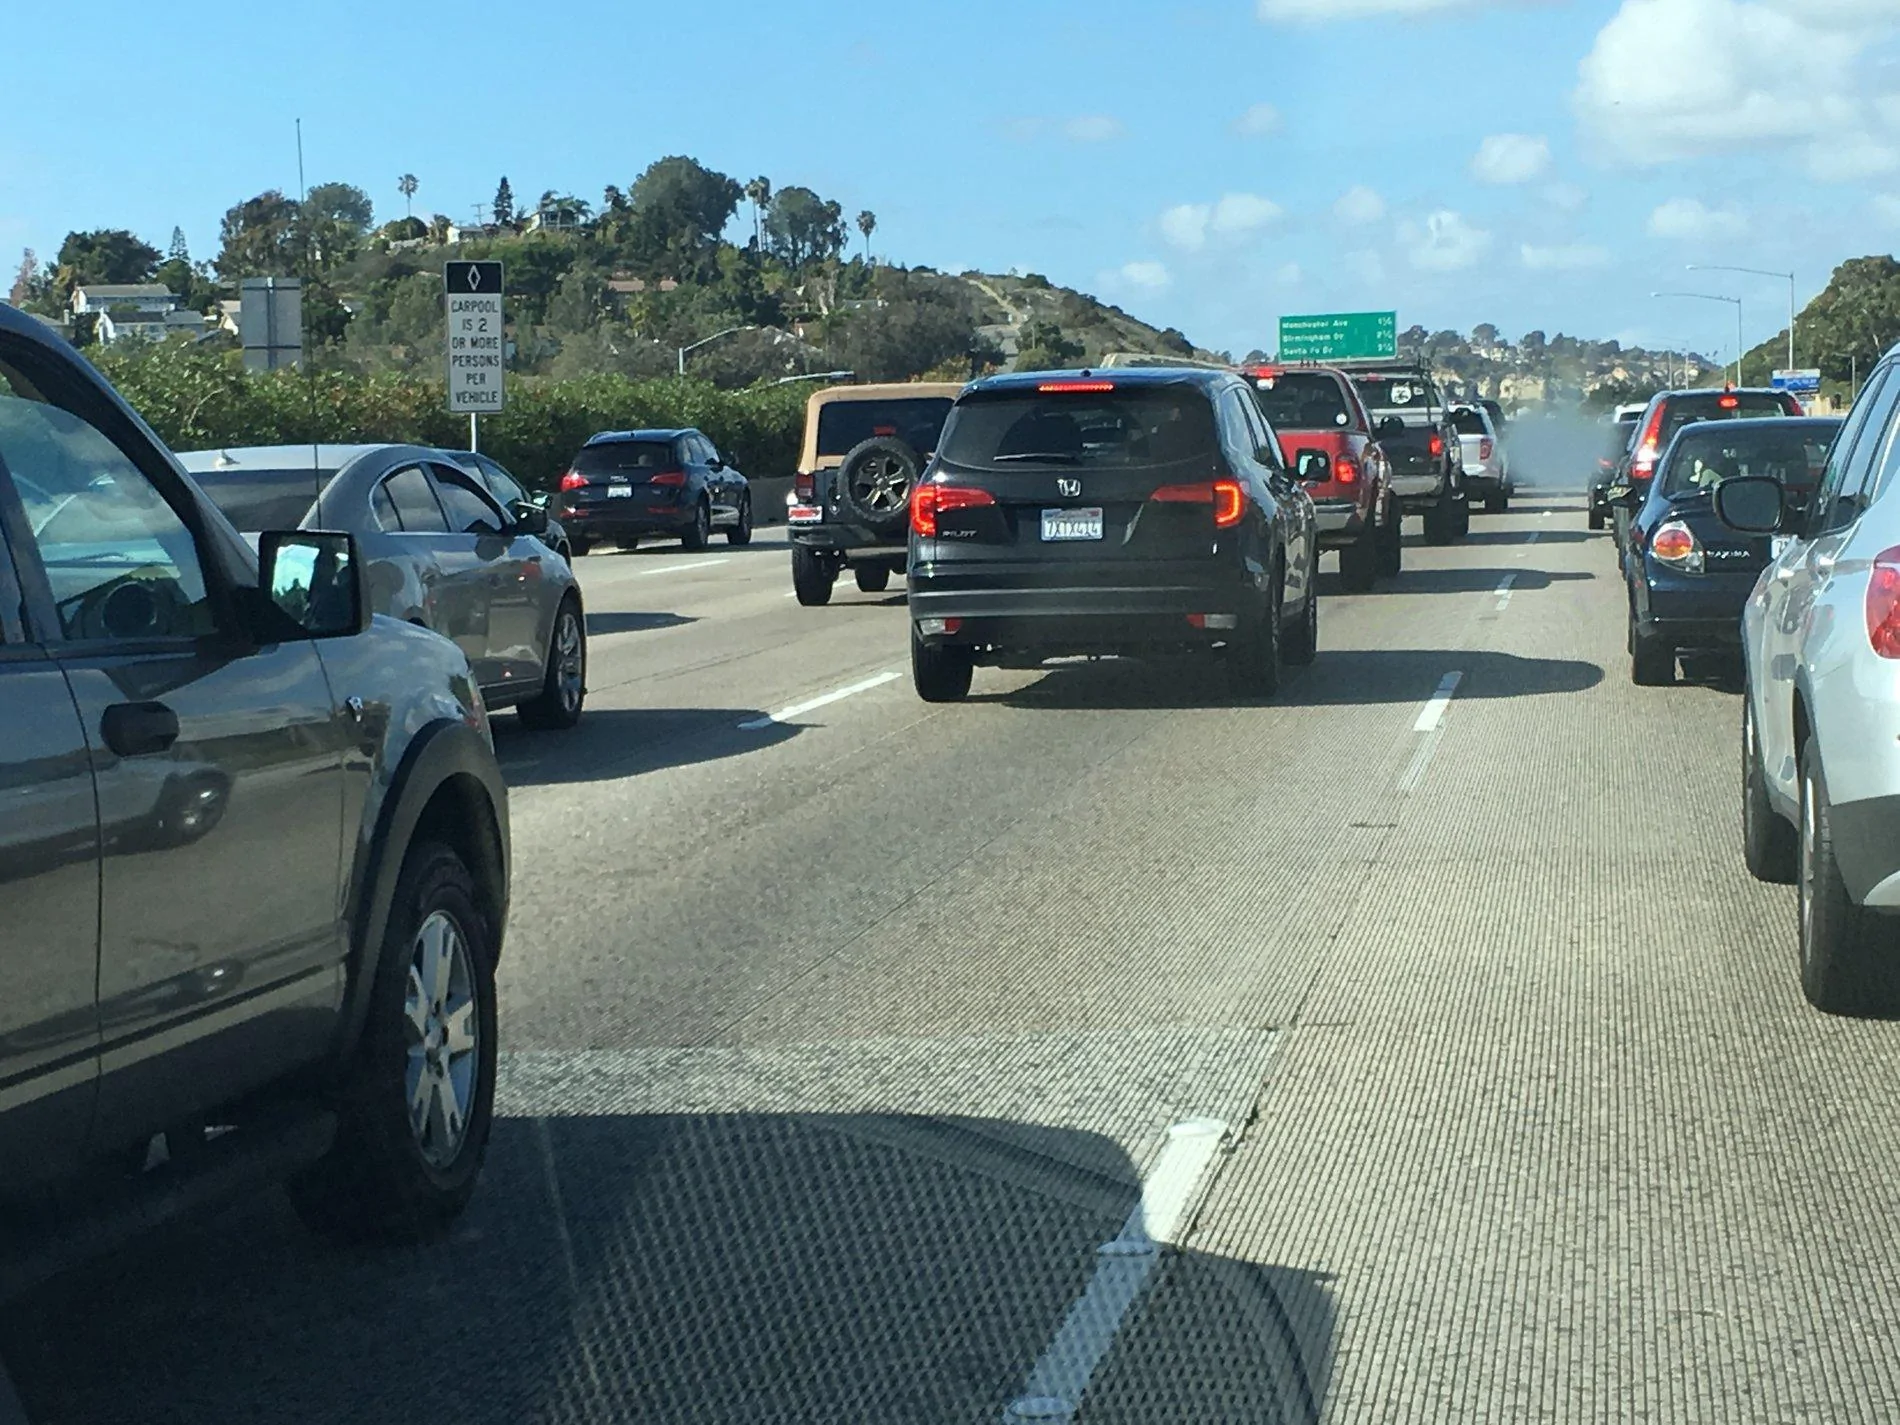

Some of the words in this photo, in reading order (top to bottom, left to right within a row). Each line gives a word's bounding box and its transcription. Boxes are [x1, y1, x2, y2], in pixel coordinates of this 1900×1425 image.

[451, 300, 499, 313] CARPOOL
[462, 318, 473, 331] IS
[478, 318, 487, 332] 2
[452, 337, 466, 349] OR
[470, 337, 499, 349] MORE
[452, 355, 500, 368] PERSONS
[465, 373, 486, 385] PER
[456, 391, 499, 404] VEHICLE
[1706, 550, 1750, 559] MAXIMA
